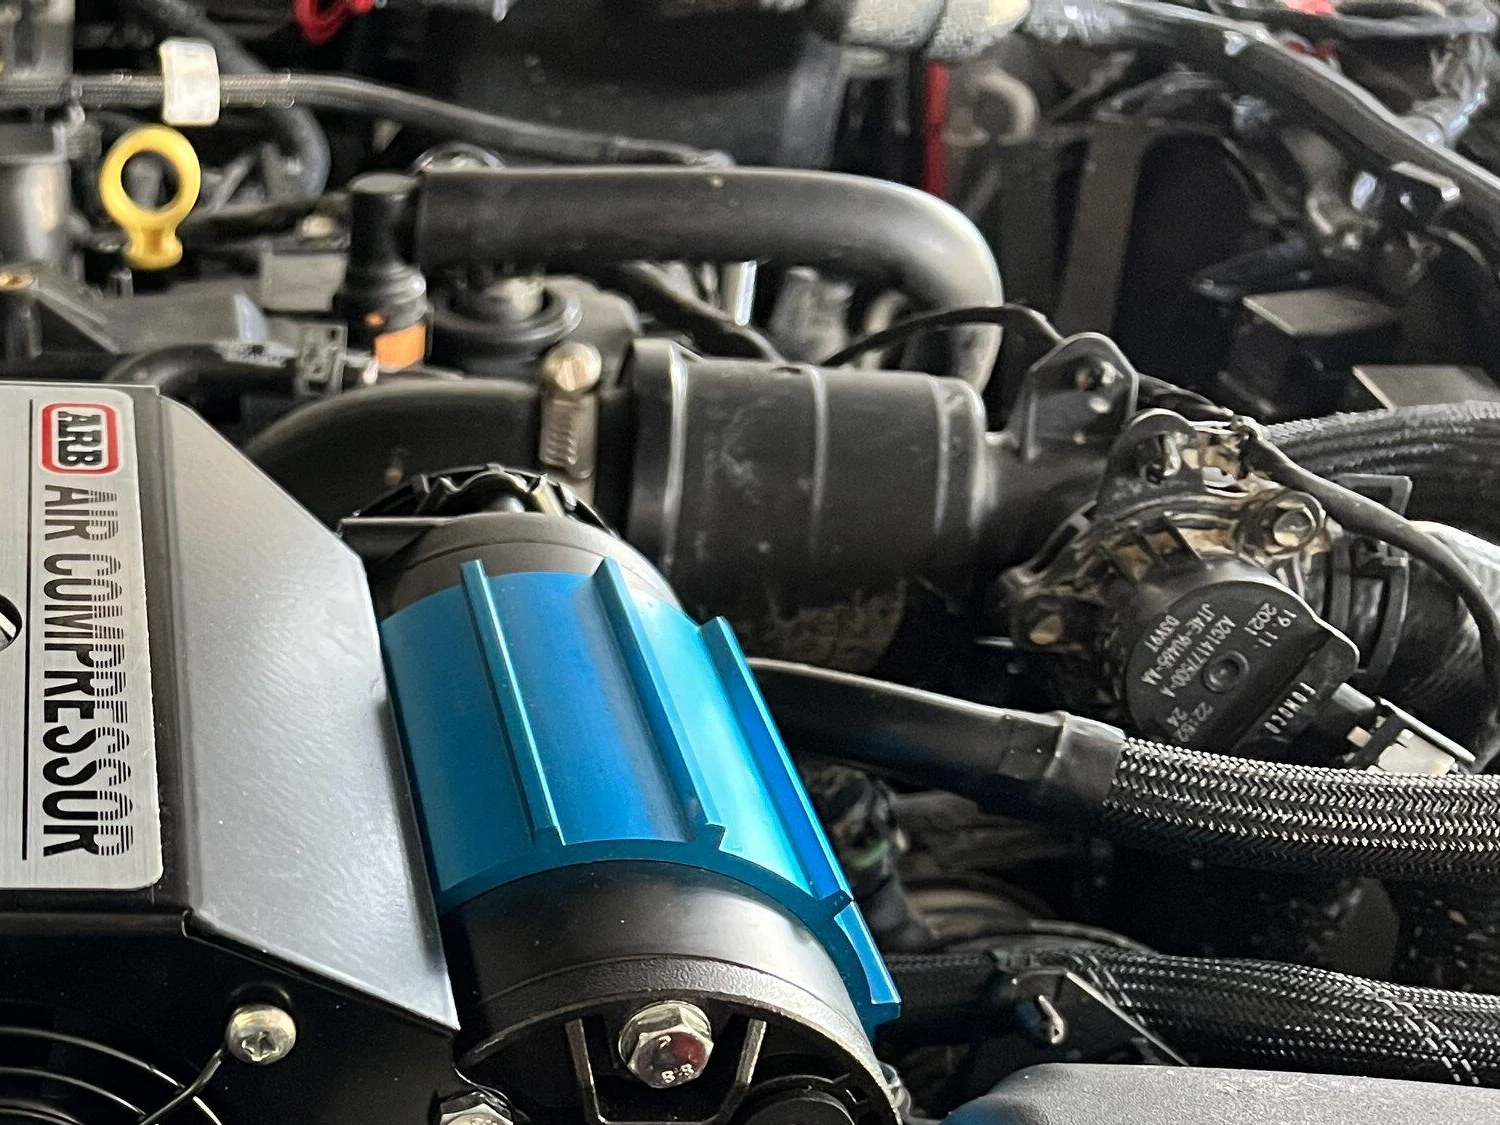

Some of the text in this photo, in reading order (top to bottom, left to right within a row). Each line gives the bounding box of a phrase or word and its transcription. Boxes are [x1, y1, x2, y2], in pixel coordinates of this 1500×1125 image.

[42, 411, 133, 858] ARB AIR COMPRESSOR
